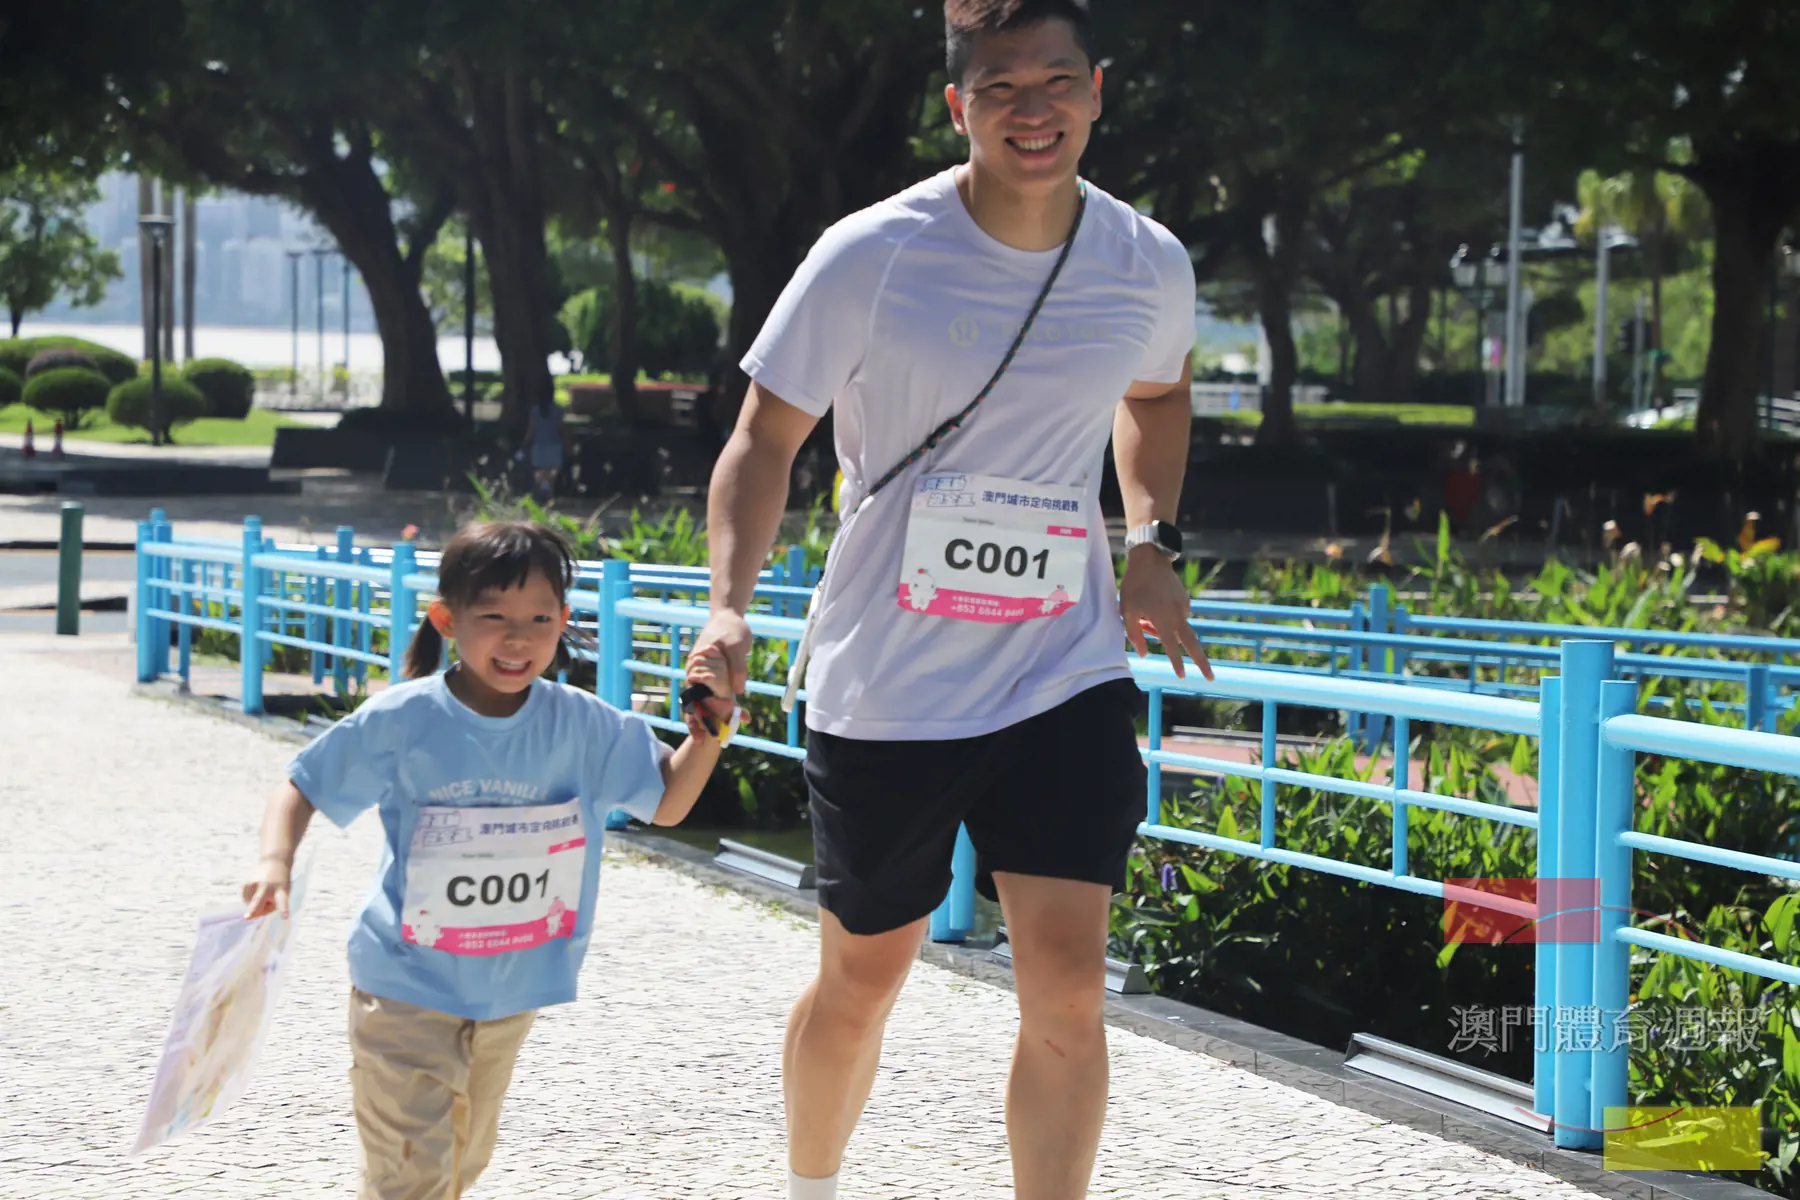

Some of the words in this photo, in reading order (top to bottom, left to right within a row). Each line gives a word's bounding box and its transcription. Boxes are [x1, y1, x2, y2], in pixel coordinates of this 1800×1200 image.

[982, 490, 1079, 513] 澳門城市定向挑戰賽
[944, 538, 1050, 580] C001
[429, 779, 473, 800] NICE
[446, 868, 550, 907] C001
